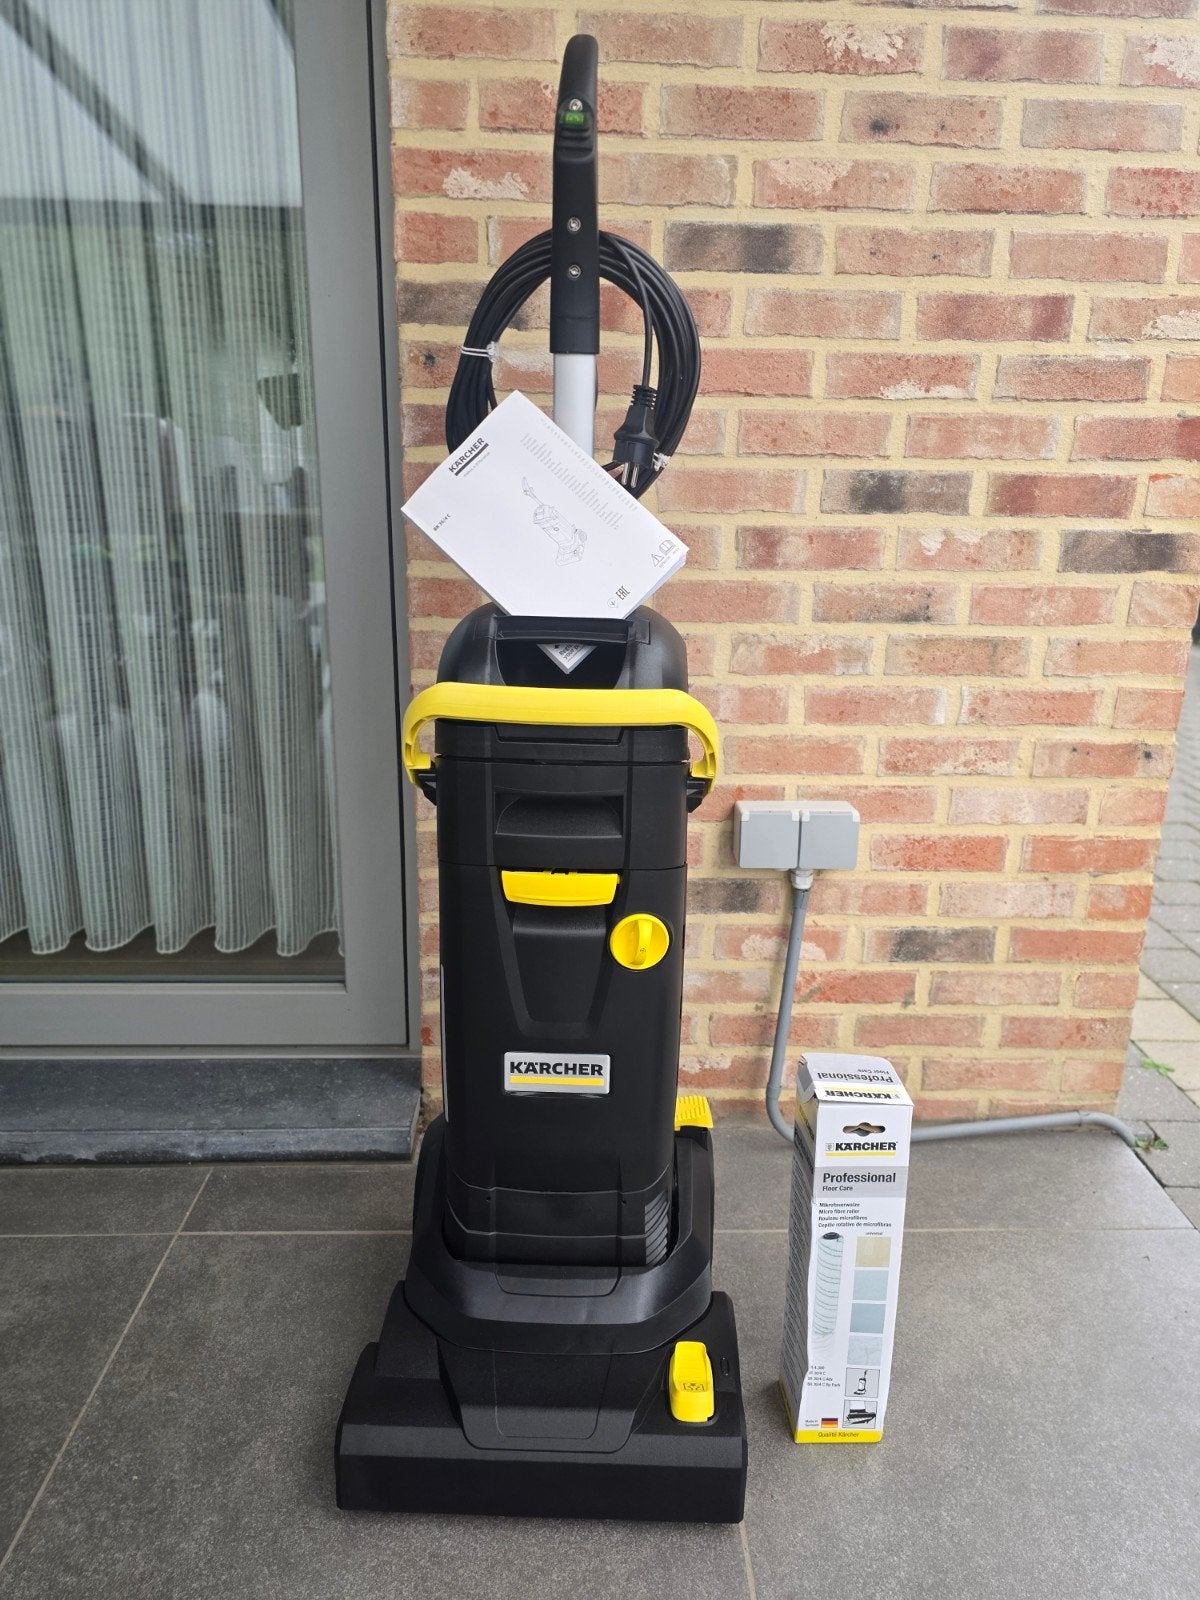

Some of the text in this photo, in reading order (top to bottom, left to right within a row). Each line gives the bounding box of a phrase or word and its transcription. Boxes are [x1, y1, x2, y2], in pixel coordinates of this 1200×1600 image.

[510, 1062, 603, 1076] KÄRCHER
[817, 1072, 894, 1083] Professional
[825, 1090, 892, 1099] KÄRCHER
[835, 1142, 896, 1151] KÄRCHER
[823, 1172, 896, 1183] Professional
